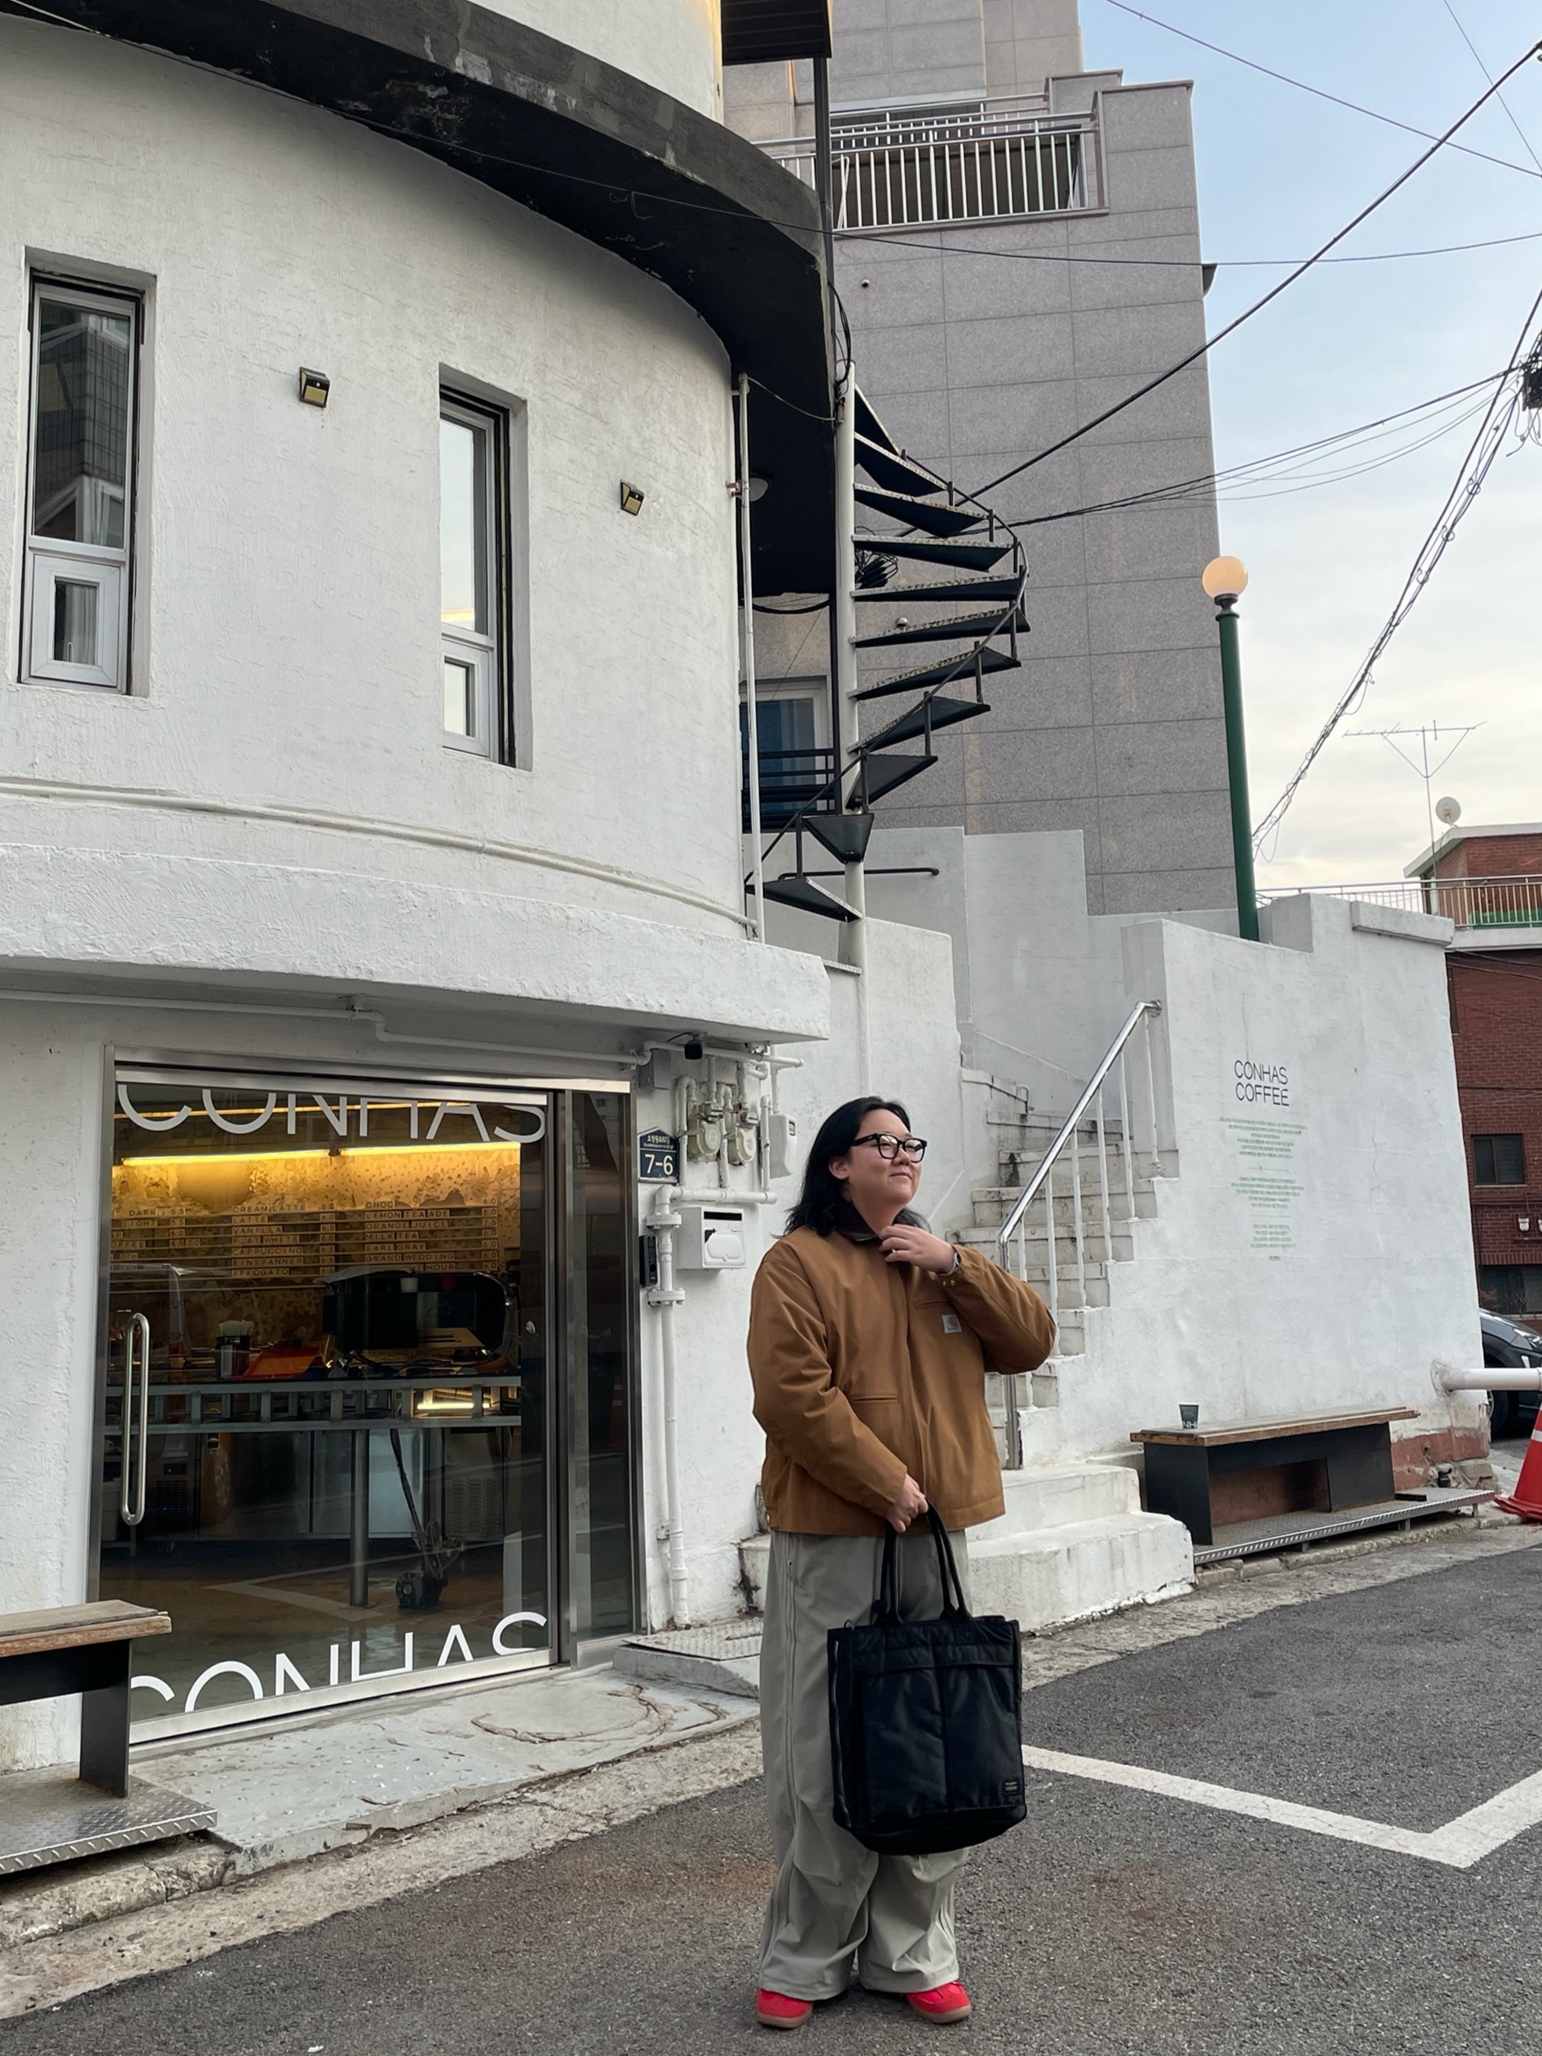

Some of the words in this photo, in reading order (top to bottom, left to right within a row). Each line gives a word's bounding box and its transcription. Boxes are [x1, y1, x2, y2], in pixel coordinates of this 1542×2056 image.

[1234, 1060, 1288, 1085] CONHAS
[1235, 1082, 1290, 1106] COFFEE
[645, 1153, 674, 1175] 7-6
[272, 1204, 306, 1212] LATTE
[129, 1209, 156, 1217] DARK
[366, 1211, 401, 1219] LEMON
[406, 1210, 426, 1218] TEA
[429, 1209, 448, 1217] ADE
[366, 1222, 408, 1230] ORANGE
[413, 1220, 448, 1228] JUICE
[233, 1226, 281, 1234] VANILLA
[232, 1247, 303, 1255] CAPPUCCINO
[366, 1244, 394, 1252] EARL
[405, 1253, 454, 1261] WEDDING
[233, 1257, 303, 1266] EINSPANNER
